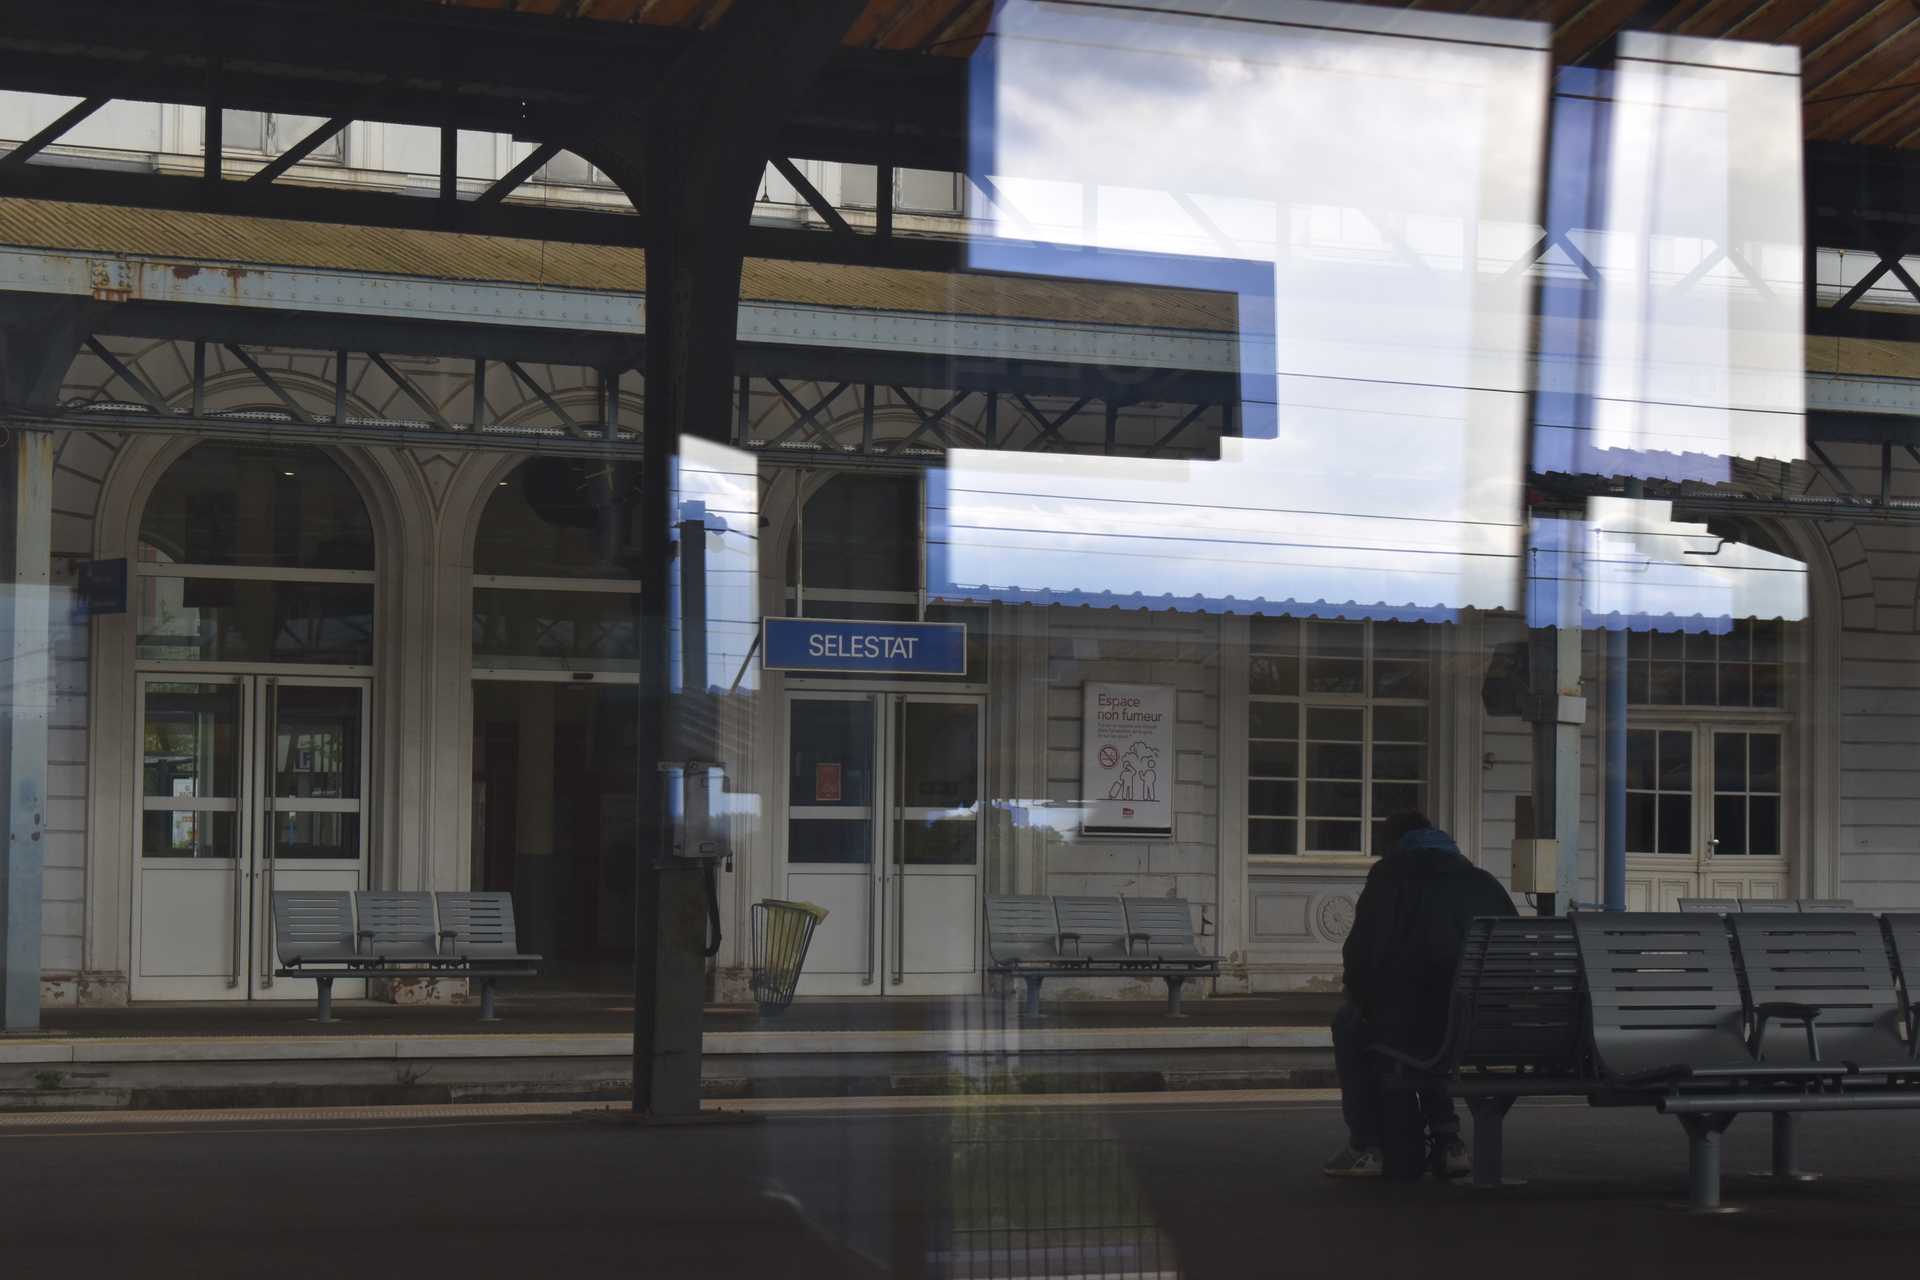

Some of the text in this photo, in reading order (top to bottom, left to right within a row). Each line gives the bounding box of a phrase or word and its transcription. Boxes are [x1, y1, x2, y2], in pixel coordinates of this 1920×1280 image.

[808, 633, 919, 659] SELESTAT
[1098, 693, 1141, 711] Espace
[1097, 707, 1163, 722] non fumeur
